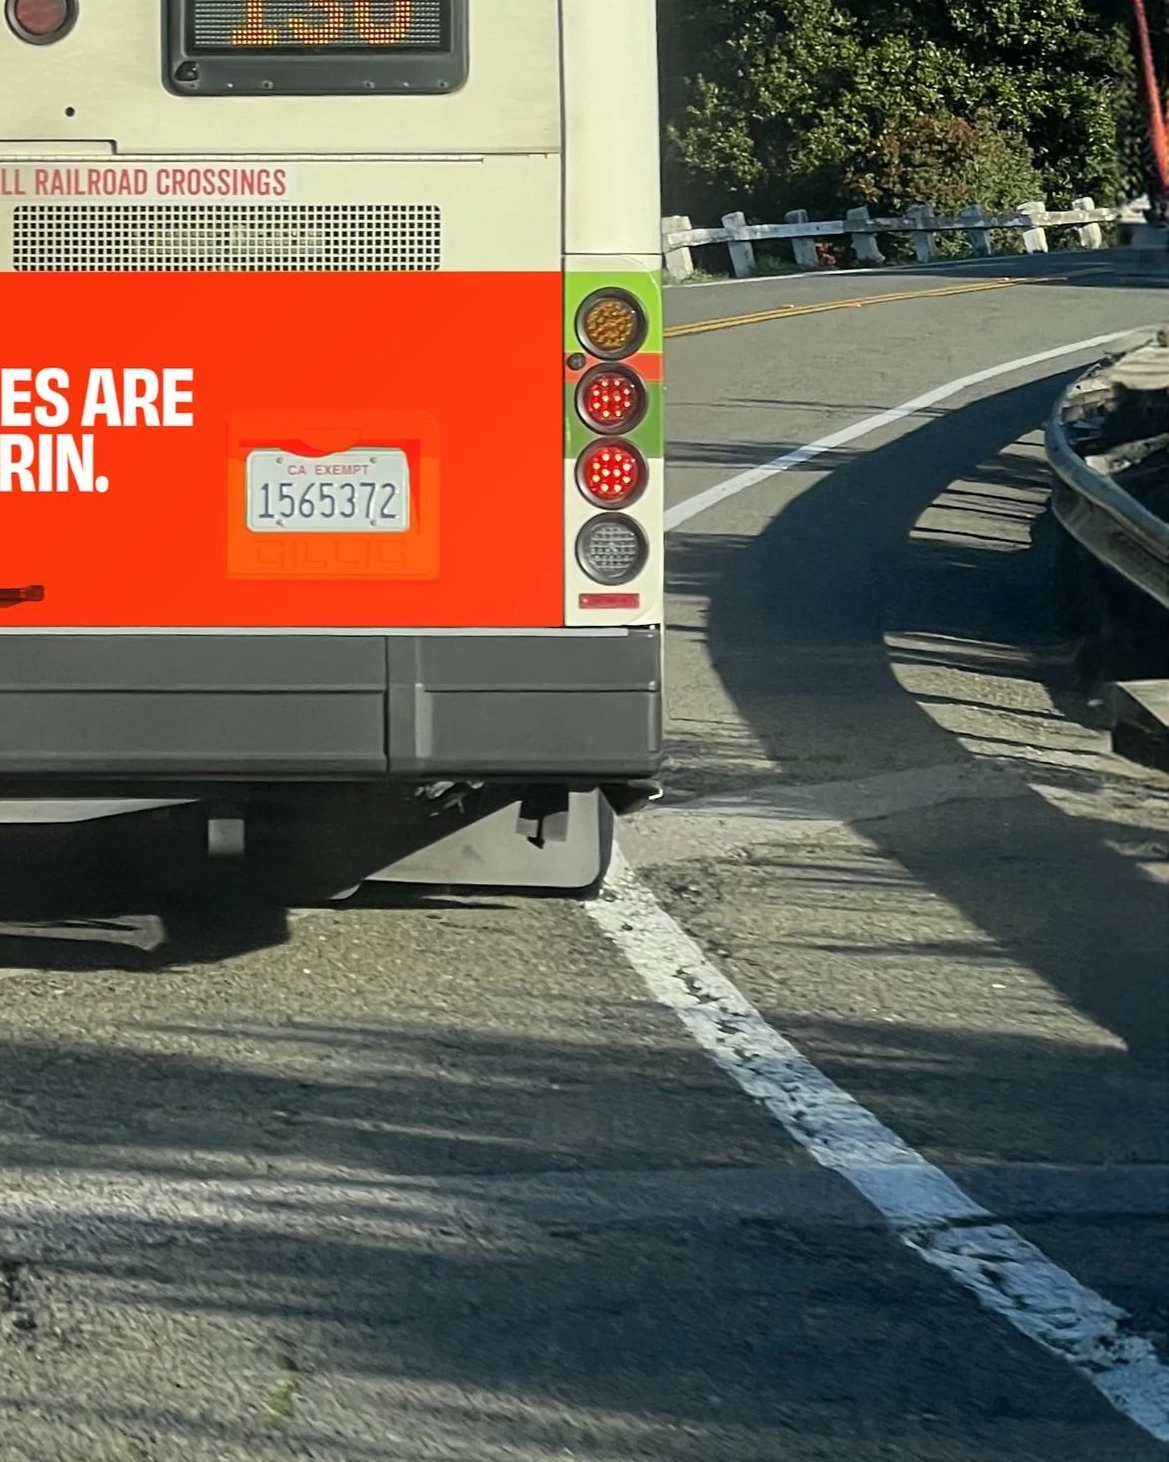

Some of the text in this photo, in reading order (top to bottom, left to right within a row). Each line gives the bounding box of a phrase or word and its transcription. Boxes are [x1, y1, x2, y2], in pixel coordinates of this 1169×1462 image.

[35, 168, 148, 196] RAILROAD
[156, 168, 286, 197] CROSSINGS
[80, 368, 194, 427] ARE
[287, 464, 369, 477] CA EXEMPT
[258, 482, 398, 519] 1565372
